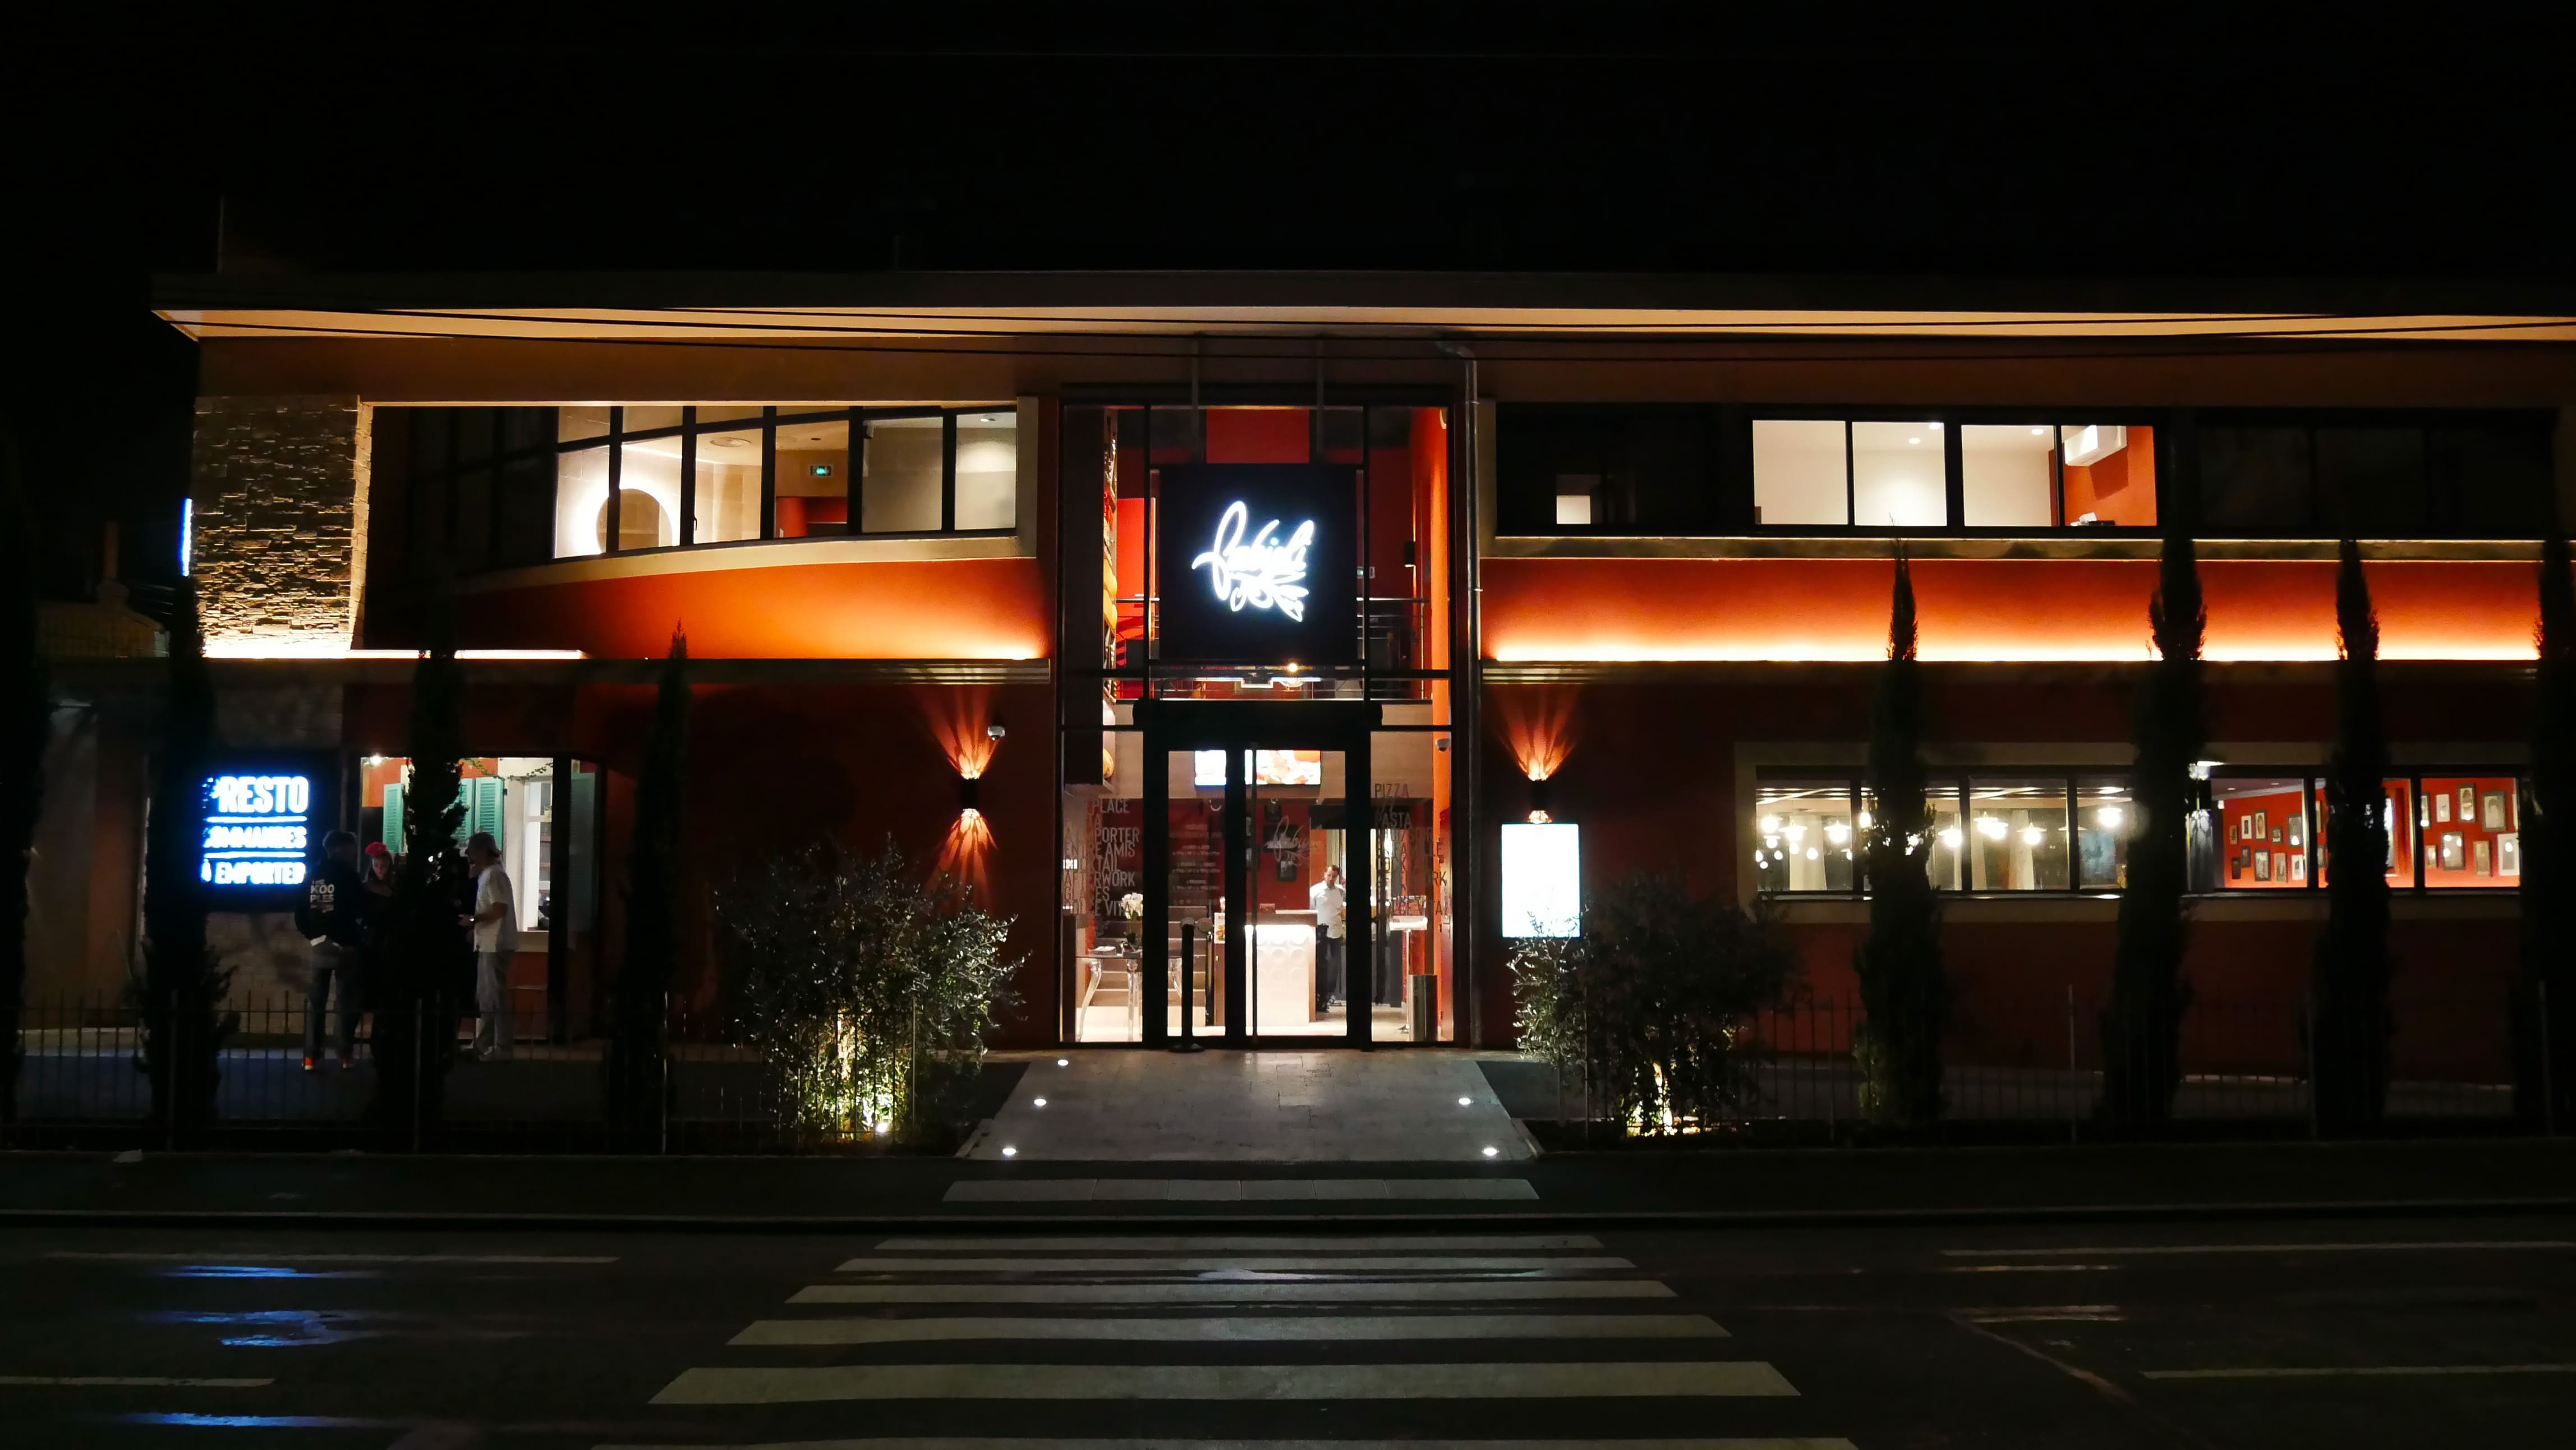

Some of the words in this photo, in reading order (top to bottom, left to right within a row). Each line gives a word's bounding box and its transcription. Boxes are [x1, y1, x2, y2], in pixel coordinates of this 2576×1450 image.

[1375, 783, 1410, 799] PIZZA
[1092, 798, 1130, 813] PLACE
[1375, 812, 1411, 828] PASTA
[1105, 842, 1135, 858] AMIS
[215, 861, 306, 884] EMPORTER
